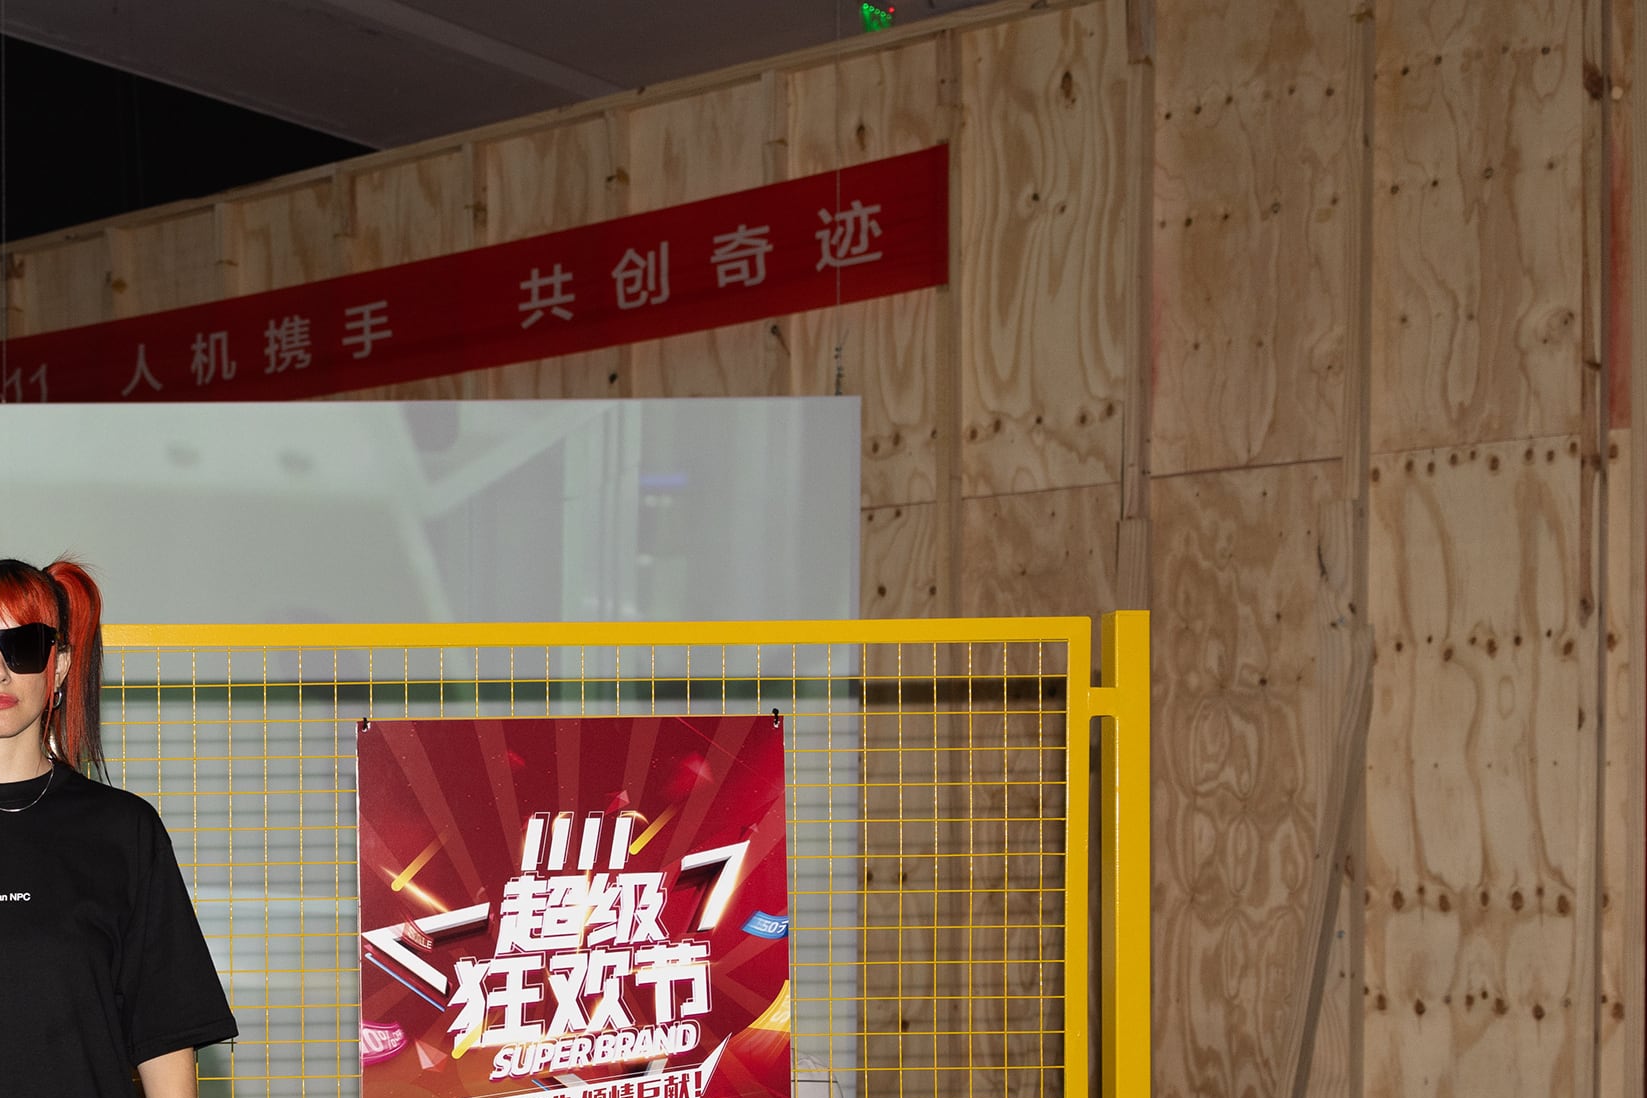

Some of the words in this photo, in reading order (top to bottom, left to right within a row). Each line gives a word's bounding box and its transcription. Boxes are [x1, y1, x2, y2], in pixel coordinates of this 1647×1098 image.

[120, 299, 393, 397] 人机携手
[517, 199, 884, 331] 共创奇迹
[9, 892, 31, 902] NPC
[494, 871, 670, 958] 超级
[447, 939, 712, 1049] 狂欢节
